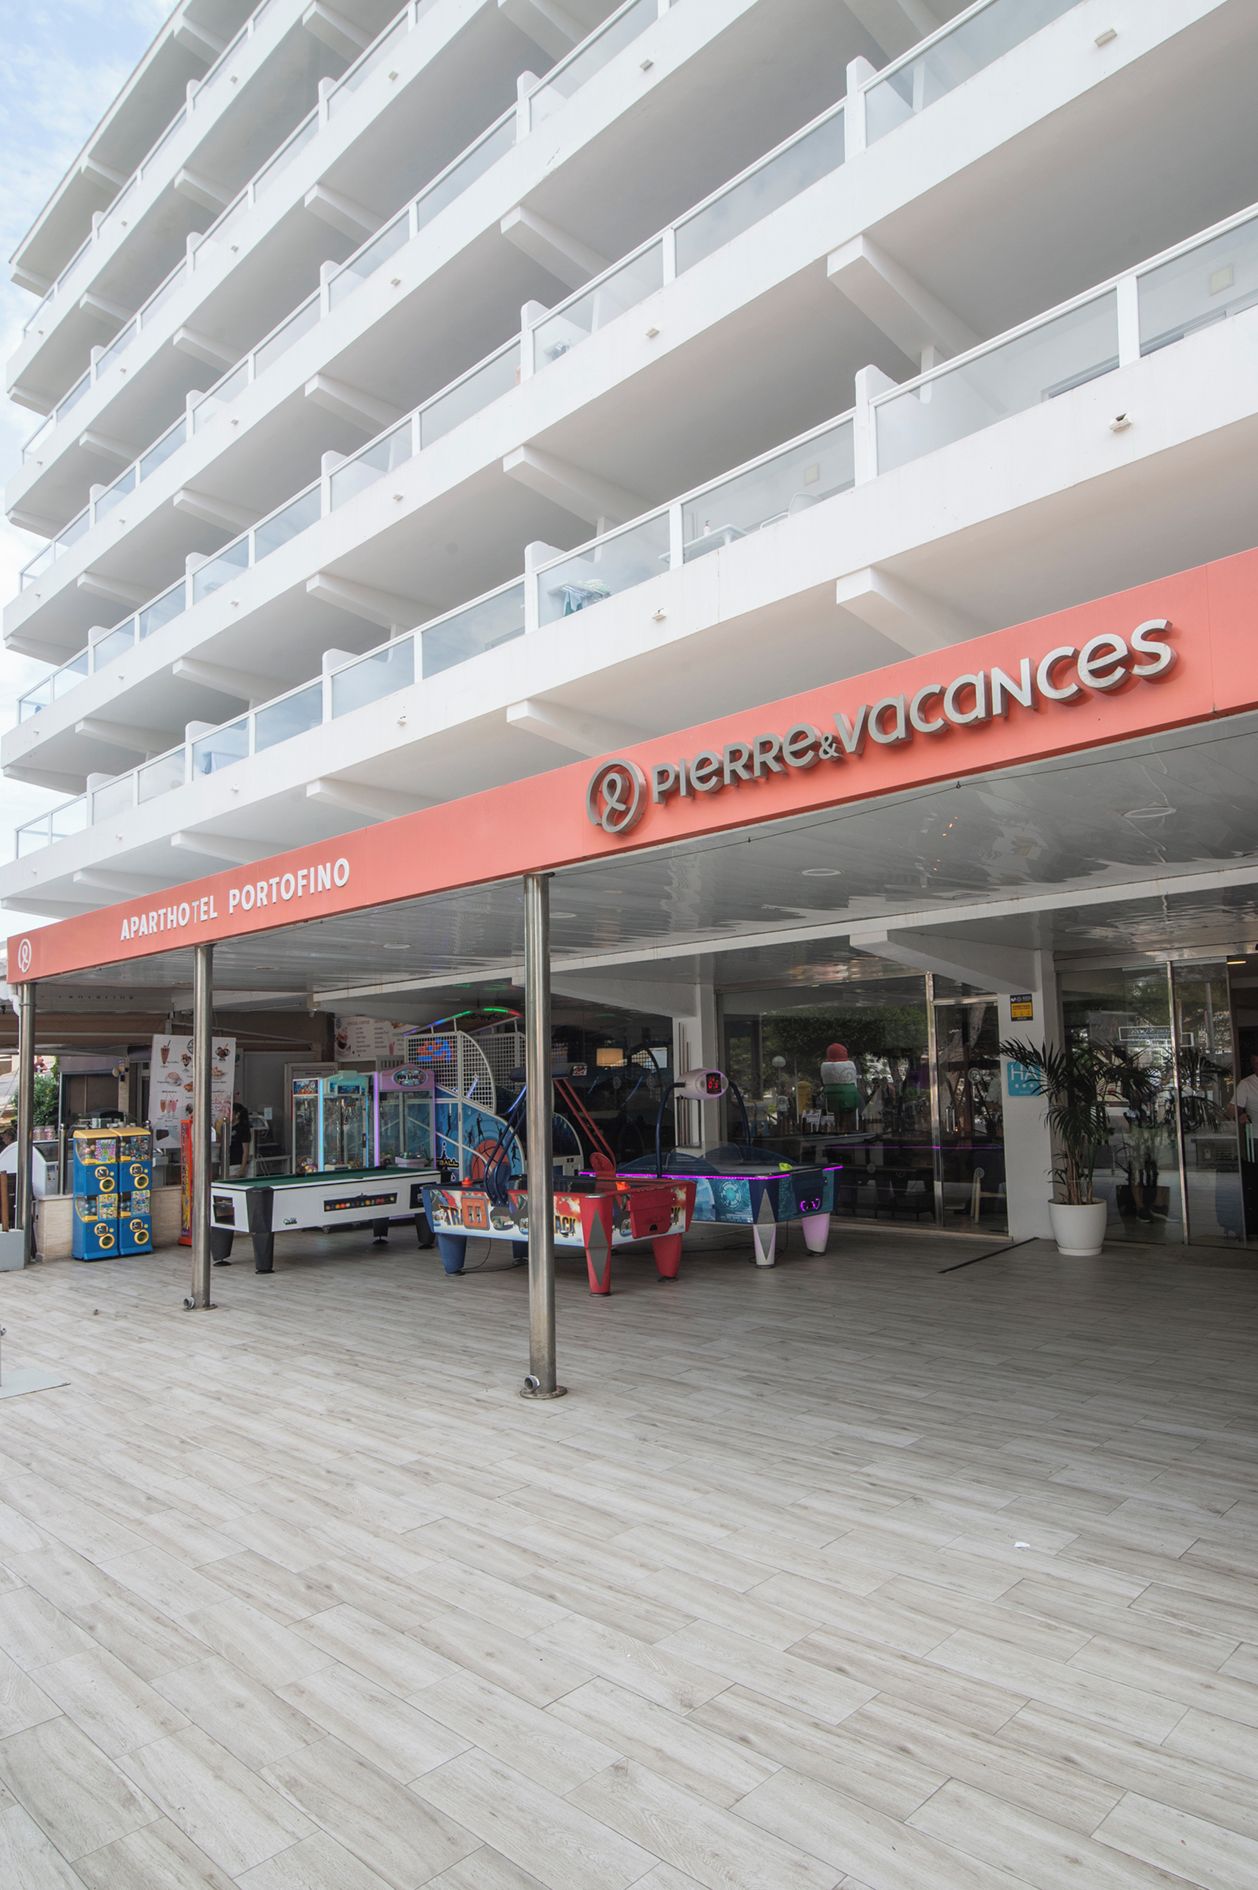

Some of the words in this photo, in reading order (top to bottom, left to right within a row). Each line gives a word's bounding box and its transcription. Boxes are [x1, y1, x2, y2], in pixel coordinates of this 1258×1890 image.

[120, 895, 218, 941] APARTHOTEL
[229, 858, 350, 914] PORTOFINO
[1011, 1064, 1038, 1080] HA
